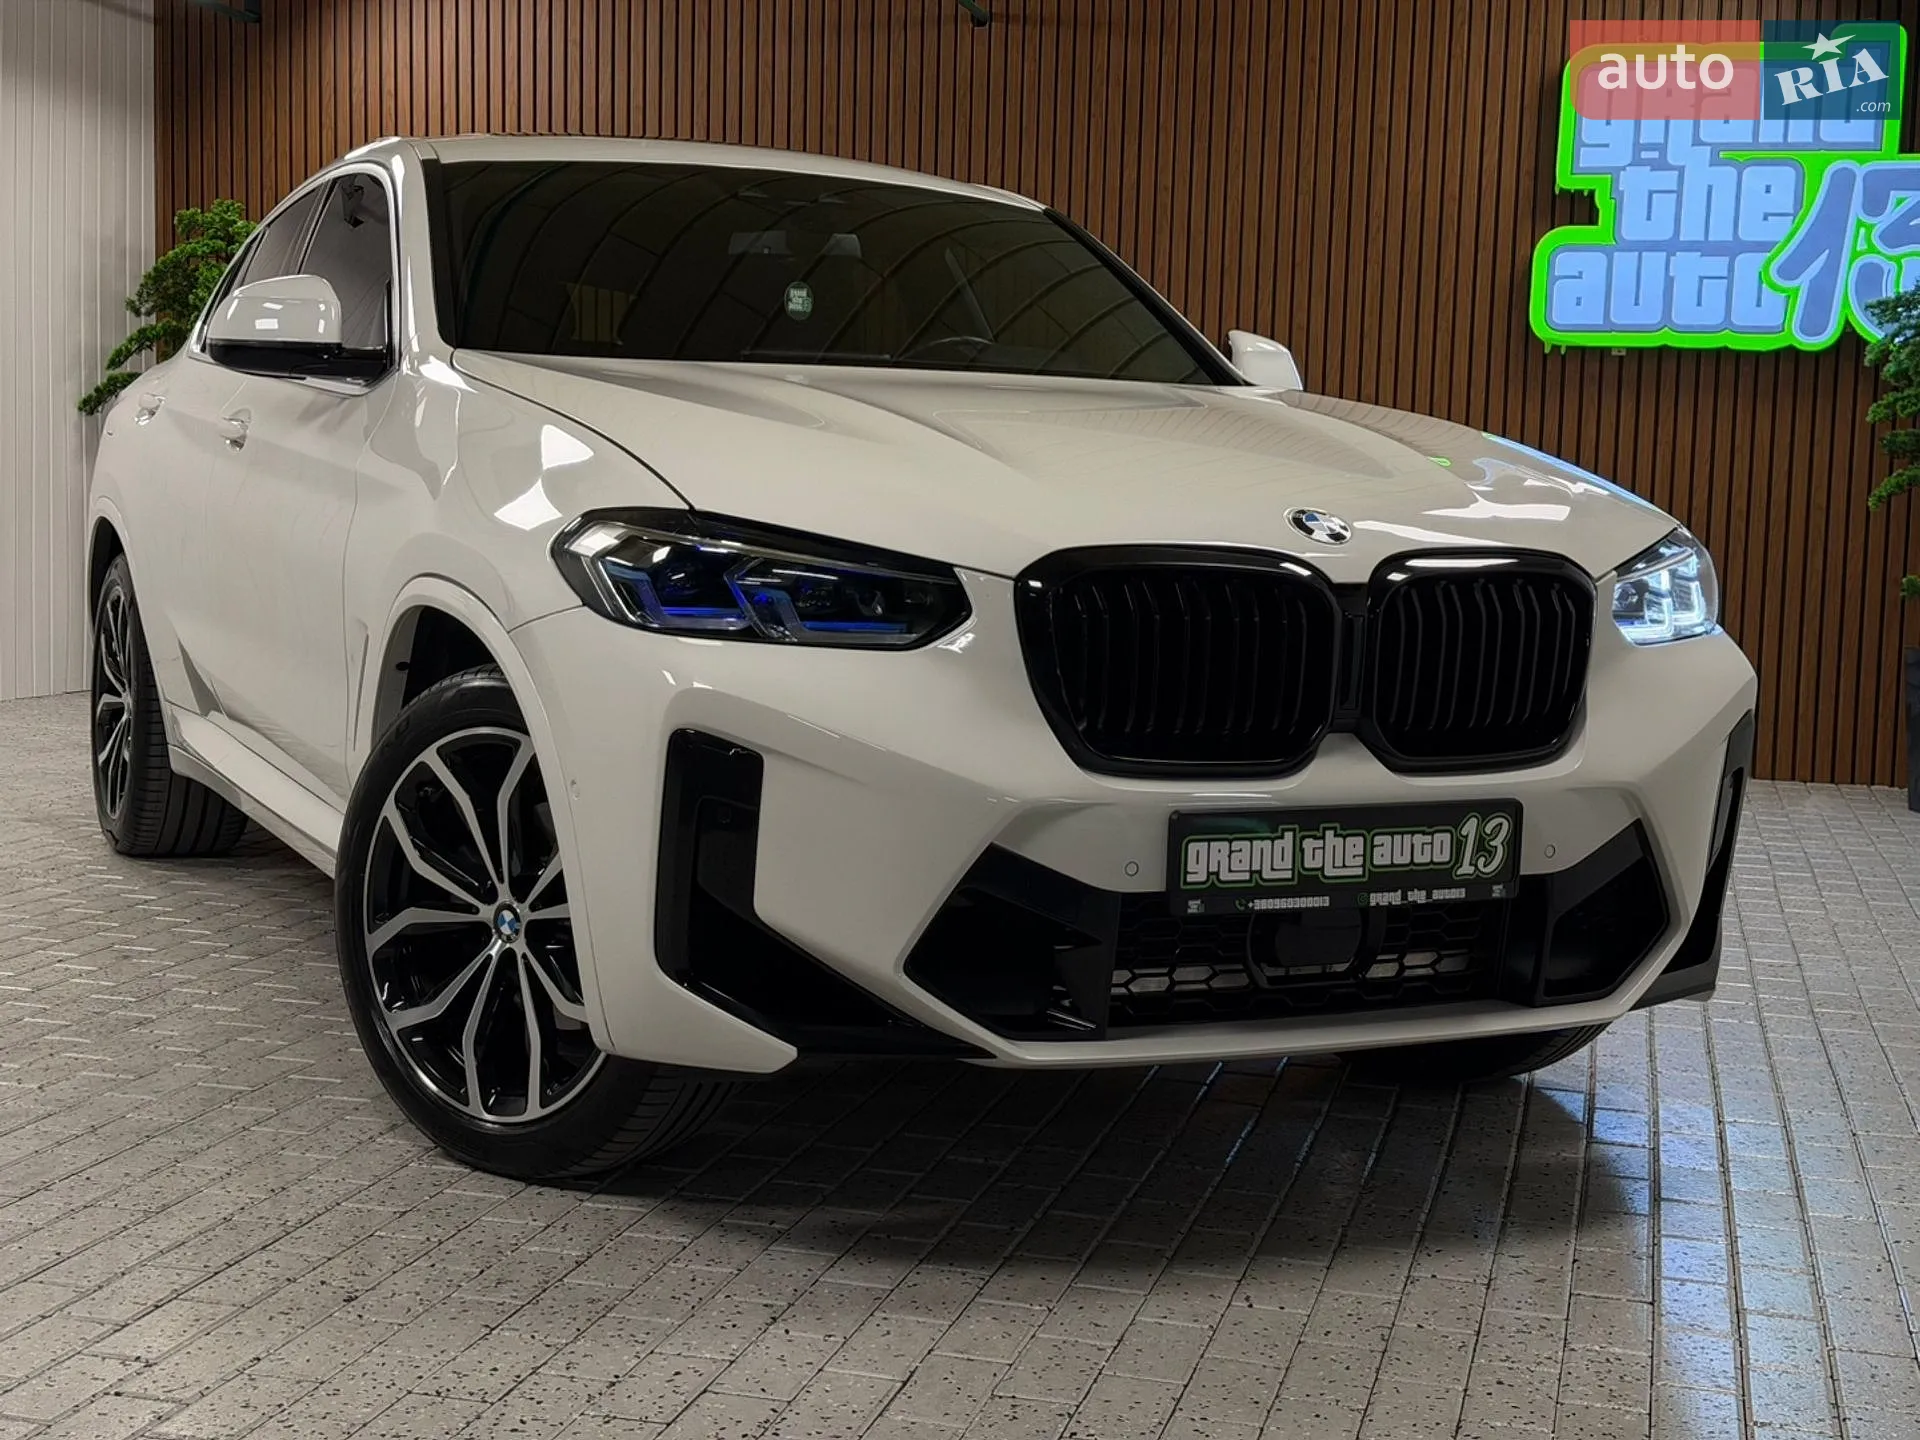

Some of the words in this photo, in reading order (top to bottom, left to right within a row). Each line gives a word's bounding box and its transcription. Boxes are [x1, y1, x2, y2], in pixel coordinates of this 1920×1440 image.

[1619, 146, 1796, 242] the
[1551, 251, 1786, 326] auto
[1186, 831, 1295, 883] grand
[1302, 828, 1365, 876] the
[1372, 831, 1451, 866] auto
[1456, 816, 1511, 876] 13
